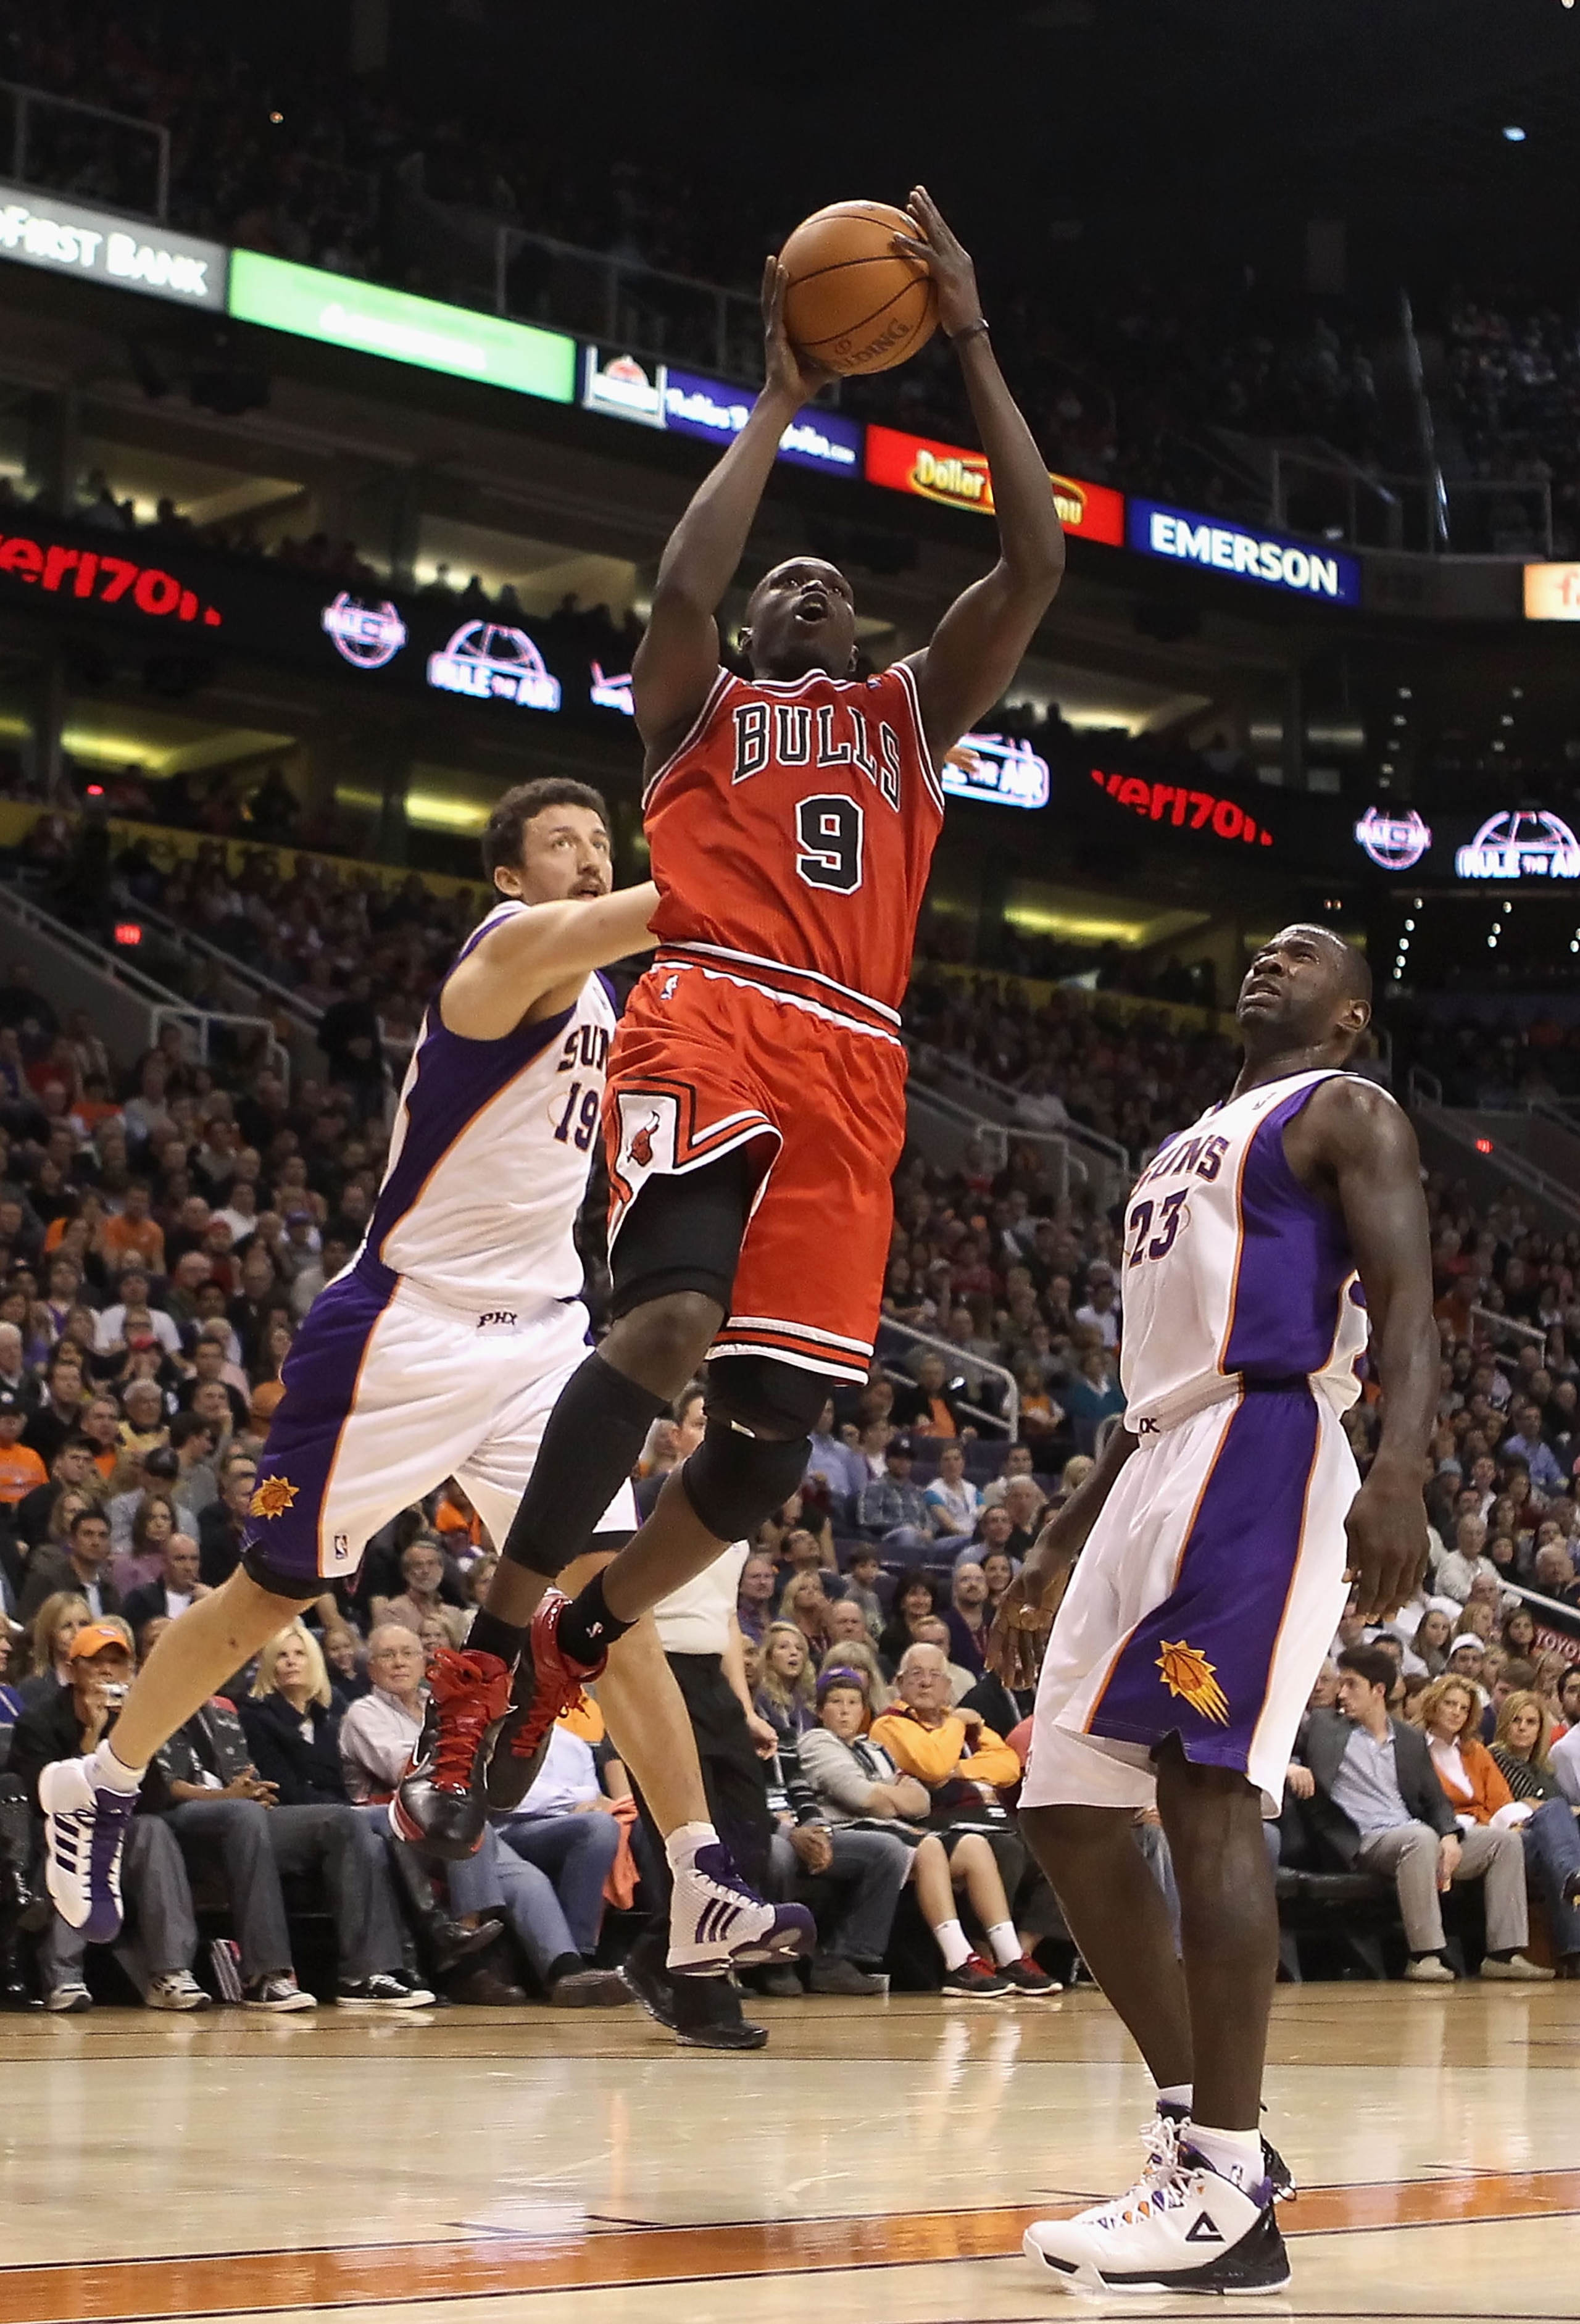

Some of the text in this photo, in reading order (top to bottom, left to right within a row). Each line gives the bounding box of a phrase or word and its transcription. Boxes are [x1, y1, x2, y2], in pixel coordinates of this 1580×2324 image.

[0, 205, 102, 267] FIRST
[916, 449, 986, 498] Dollar
[1150, 512, 1338, 597] EMERSON
[732, 701, 900, 814] BULLS
[796, 794, 863, 895] 9
[557, 1023, 610, 1074] SUN
[554, 1081, 600, 1154] 19
[1129, 1186, 1189, 1270] 23
[476, 1311, 518, 1328] PHX
[1535, 1625, 1580, 1665] TOYO
